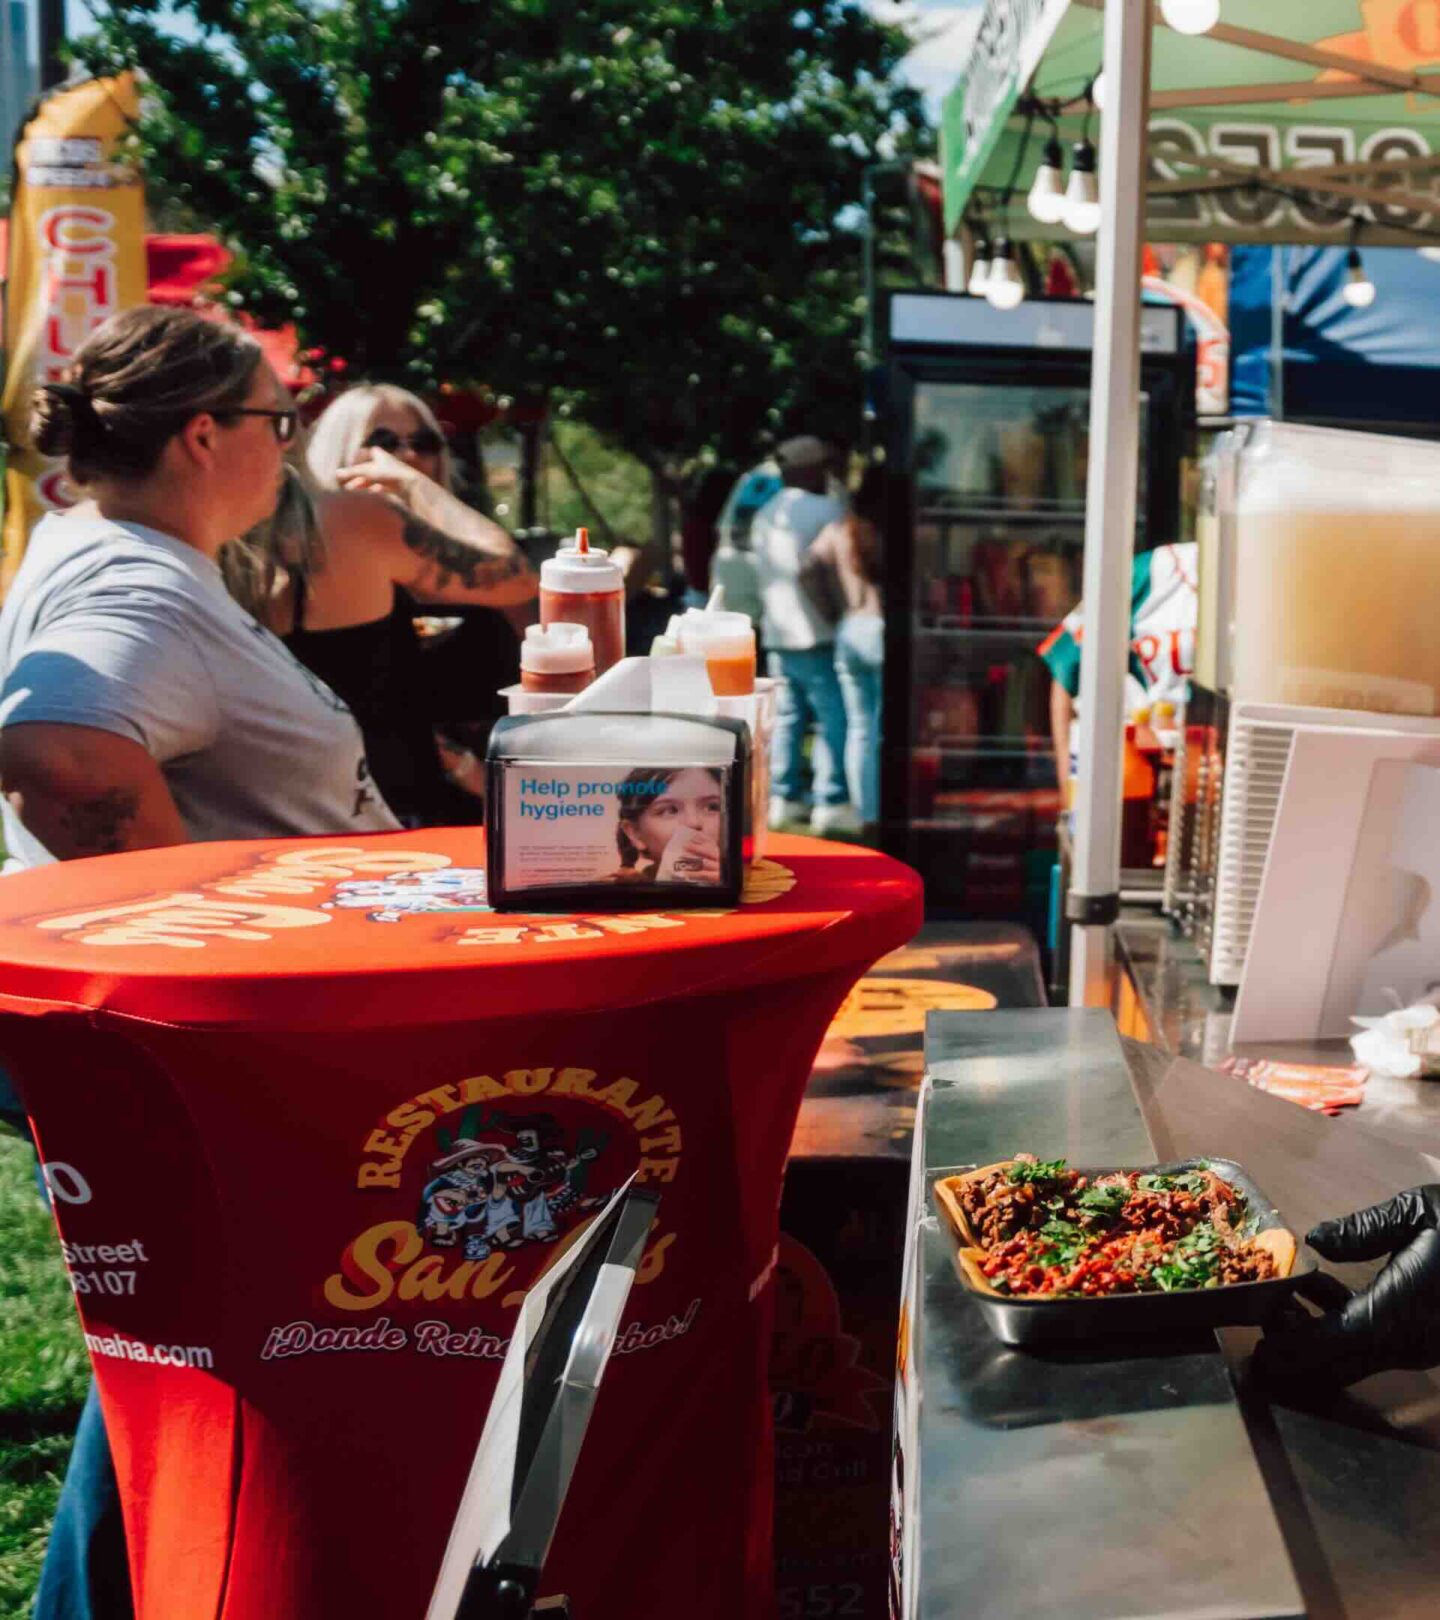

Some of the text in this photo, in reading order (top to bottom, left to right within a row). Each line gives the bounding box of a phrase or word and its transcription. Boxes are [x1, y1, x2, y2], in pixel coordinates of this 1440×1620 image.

[520, 778, 668, 799] Help promote
[520, 800, 605, 820] hygiene
[357, 1066, 684, 1189] RESTAURANTE
[70, 1270, 137, 1296] 8107
[323, 1220, 514, 1311] San
[609, 1297, 702, 1358] abor!
[84, 1332, 215, 1370] maha.com
